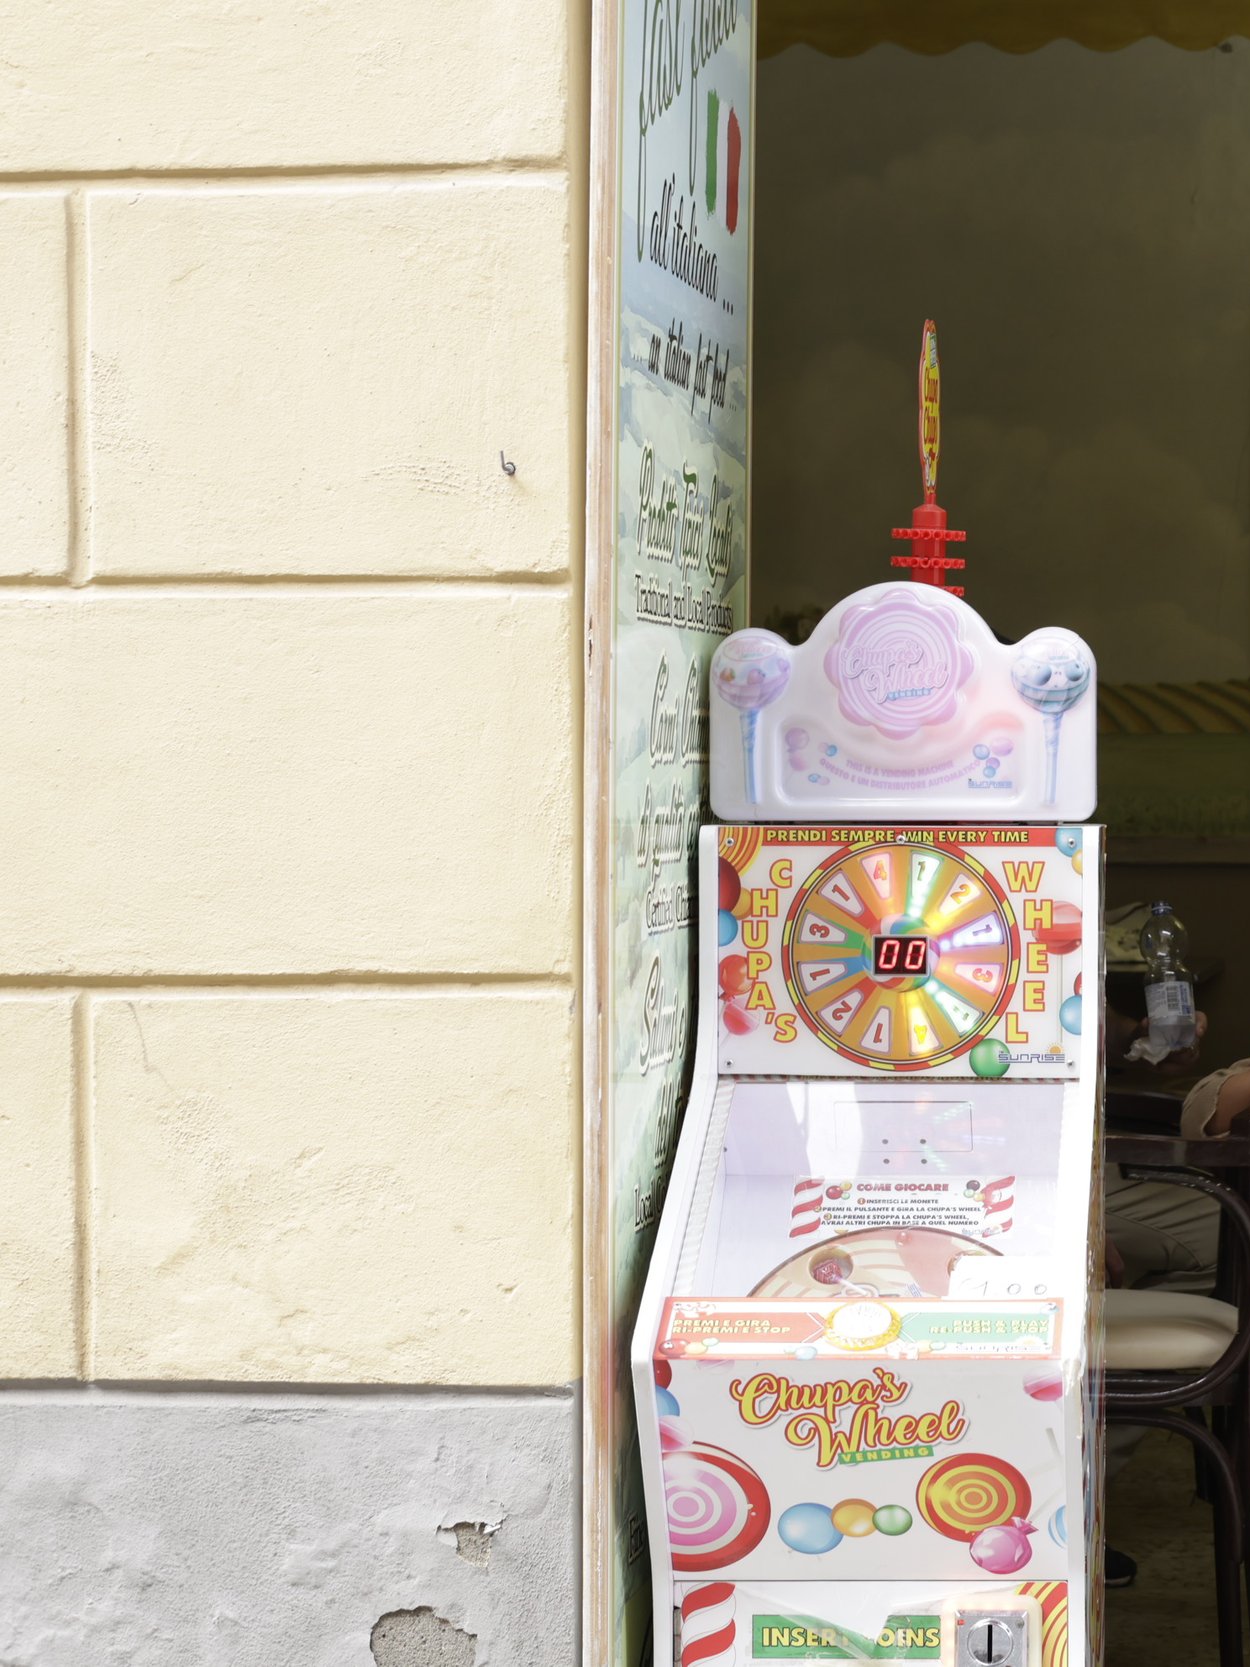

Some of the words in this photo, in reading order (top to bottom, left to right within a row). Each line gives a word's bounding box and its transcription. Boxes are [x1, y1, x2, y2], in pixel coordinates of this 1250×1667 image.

[664, 317, 692, 392] italian
[766, 829, 827, 843] PRENDI
[831, 829, 895, 843] SEMPRE
[902, 829, 935, 843] WIN
[937, 829, 990, 843] EVERY
[991, 829, 1029, 843] TIME
[878, 940, 927, 970] 00
[998, 1053, 1066, 1064] SUNRISE
[856, 1183, 892, 1193] COME
[894, 1183, 949, 1193] GIOCARE
[672, 1326, 740, 1334] RI-PREMI
[753, 1326, 791, 1334] STOP
[673, 1319, 720, 1327] PREMI
[735, 1319, 772, 1327] GIRA
[952, 1319, 992, 1327] PUSH
[1010, 1319, 1048, 1327] PLAY
[1010, 1326, 1048, 1334] STOP
[730, 1367, 909, 1425] Chupa's
[785, 1399, 965, 1468] Wheel
[842, 1447, 930, 1463] VENDING
[762, 1627, 848, 1649] INSER
[875, 1627, 940, 1649] OINS
